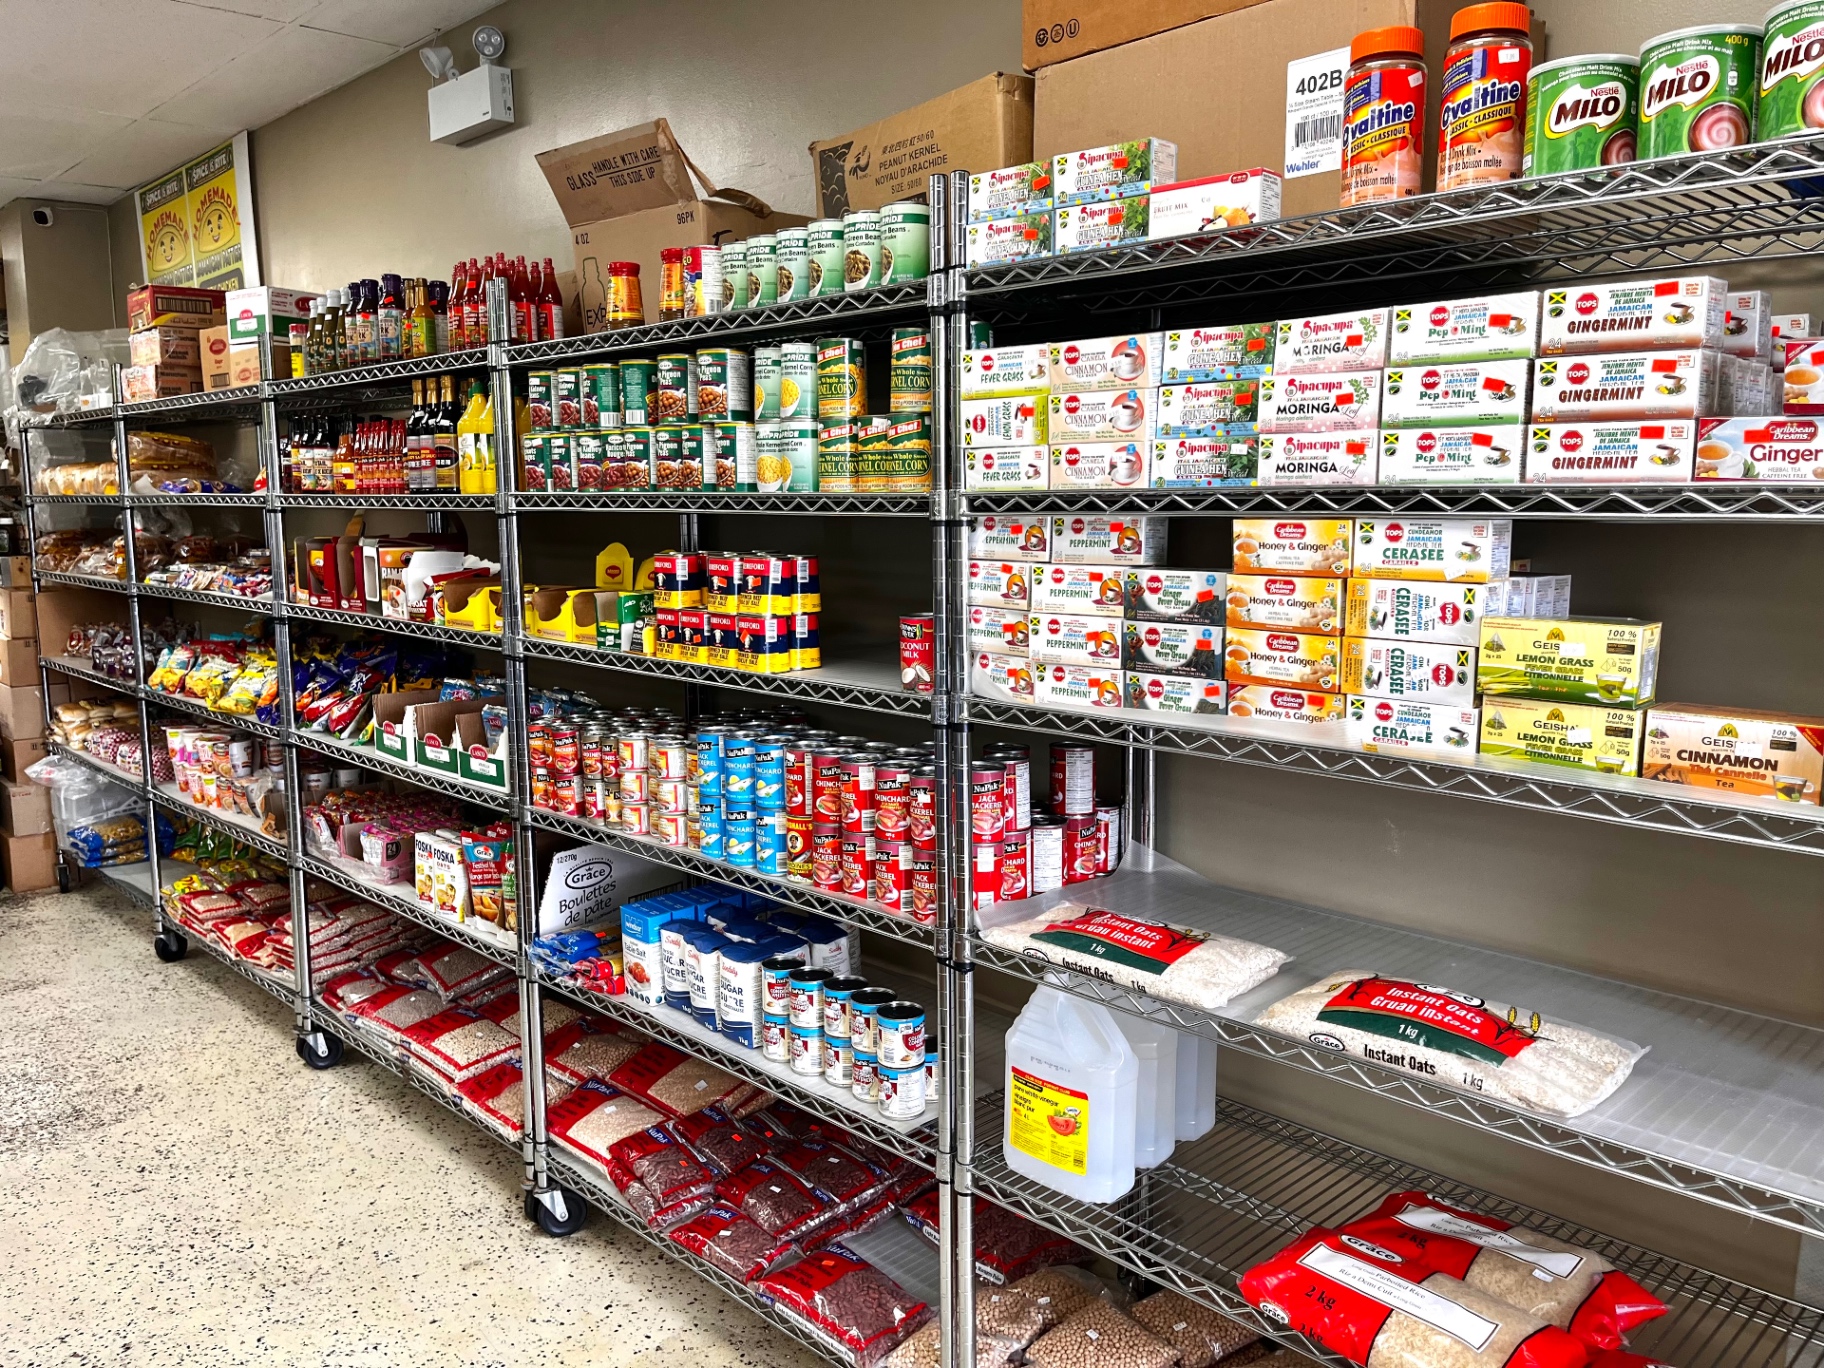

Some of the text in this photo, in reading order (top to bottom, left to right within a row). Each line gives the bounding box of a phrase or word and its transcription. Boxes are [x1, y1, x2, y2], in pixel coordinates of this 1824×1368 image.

[1725, 35, 1748, 46] 400 g
[1676, 60, 1708, 75] Nestlé
[1296, 69, 1342, 95] 402B
[1591, 87, 1619, 97] Nestlé
[1647, 71, 1710, 109] MILO
[1442, 80, 1521, 129] Ovaltine
[1555, 96, 1620, 126] MILO
[1342, 101, 1415, 148] Ovaltine
[592, 145, 661, 174] HANDLE WITH CARE
[879, 143, 941, 171] PEANUT KERNEL
[875, 154, 947, 186] NOYAU D'ARACHIDE
[567, 171, 598, 191] GLASS
[609, 166, 656, 188] THIS SIDE UP
[193, 186, 239, 241] HOMEMADE
[676, 211, 695, 225] 96PK
[147, 211, 189, 261] HOMEMADE
[575, 233, 590, 245] 4 OZ
[781, 239, 804, 248] PRIDE
[1577, 299, 1597, 309] TOPS
[1607, 303, 1652, 313] JAMAICAN
[1428, 324, 1487, 338] Pep Mint
[1567, 316, 1652, 334] GINGERMINT
[902, 335, 923, 347] Chef
[701, 365, 721, 375] Pigeon
[800, 363, 813, 371] Corn
[1065, 363, 1108, 376] CINNAMON
[908, 376, 931, 387] CORN
[981, 371, 1024, 384] FEVER GRASS
[1599, 374, 1645, 383] JAMAICAN
[1285, 378, 1343, 397] Sipacupa
[1419, 389, 1477, 401] Pep Mint
[1558, 387, 1644, 403] GINGERMINT
[1065, 401, 1080, 409] TOPS
[1277, 403, 1340, 415] MORINGA
[1002, 401, 1012, 440] LEMON GRASS
[1065, 414, 1107, 425] CINNAMON
[1769, 424, 1814, 435] Caribbean
[1774, 431, 1808, 440] Dreams
[1176, 440, 1228, 458] Sipacupa
[1284, 437, 1340, 456] Sipacupa
[1066, 453, 1080, 461] TOPS
[1750, 444, 1822, 464] Ginger
[905, 460, 928, 471] CORN
[1275, 461, 1338, 474] MORINGA
[1552, 456, 1638, 470] GINGERMINT
[983, 471, 1021, 482] FEVER GRASS
[1065, 466, 1106, 477] CINNAMON
[1069, 539, 1111, 548] PEPPERMINT
[1259, 542, 1328, 552] Honey & Ginger
[1382, 548, 1444, 561] CERASEE
[1050, 588, 1093, 598] PEPPERMINT
[1250, 596, 1277, 607] Honey
[1286, 598, 1317, 609] Ginger
[1395, 587, 1411, 635] CERASEE
[1607, 629, 1637, 639] 100 %
[1046, 639, 1089, 650] PEPPERMINT
[1250, 652, 1318, 667] Honey & Ginger
[1516, 653, 1594, 668] LEMON GRASS
[1390, 648, 1405, 695] CERASEE
[1524, 671, 1584, 682] CITRONNELLE
[1051, 687, 1092, 698] PEPPERMINT
[1272, 693, 1303, 703] Caribbean
[1163, 695, 1184, 704] Ginger
[1255, 707, 1325, 723] Honey & Ginger
[1533, 720, 1577, 731] GEISHA
[1516, 732, 1554, 744] LEMON
[1524, 751, 1583, 763] CITRONNELLE
[1676, 749, 1778, 771] CINNAMON
[1689, 764, 1711, 774] Thé
[878, 781, 902, 790] NuPak
[974, 783, 1000, 793] NuPak
[1716, 779, 1735, 788] Tea
[875, 794, 910, 803] CHINCHARD
[416, 840, 432, 853] FOSKA
[434, 848, 454, 864] FOSKA
[813, 854, 842, 862] MACKEREL
[572, 869, 605, 883] Grace
[915, 874, 928, 882] JACK
[559, 880, 616, 913] Boulettes
[565, 898, 611, 926] de pâte
[1091, 913, 1163, 942] Instant Oats
[1110, 930, 1156, 949] instant
[1062, 957, 1114, 983] Instant Oats
[721, 980, 743, 996] SUGAR
[1386, 987, 1485, 1024] Instant Oats
[1370, 996, 1480, 1036] Gruau instant
[1399, 1024, 1419, 1039] 1 kg
[1313, 1036, 1341, 1050] Grace
[1363, 1044, 1436, 1076] Instant Oats
[1409, 1234, 1428, 1249] kg
[1498, 1235, 1514, 1246] Rice
[1347, 1236, 1395, 1260] Grace
[1338, 1268, 1351, 1276] Riz
[1358, 1276, 1377, 1289] Demi
[1377, 1285, 1393, 1296] Cuit
[1375, 1272, 1426, 1299] Parboiled Rice
[1305, 1286, 1337, 1311] 2 kg
